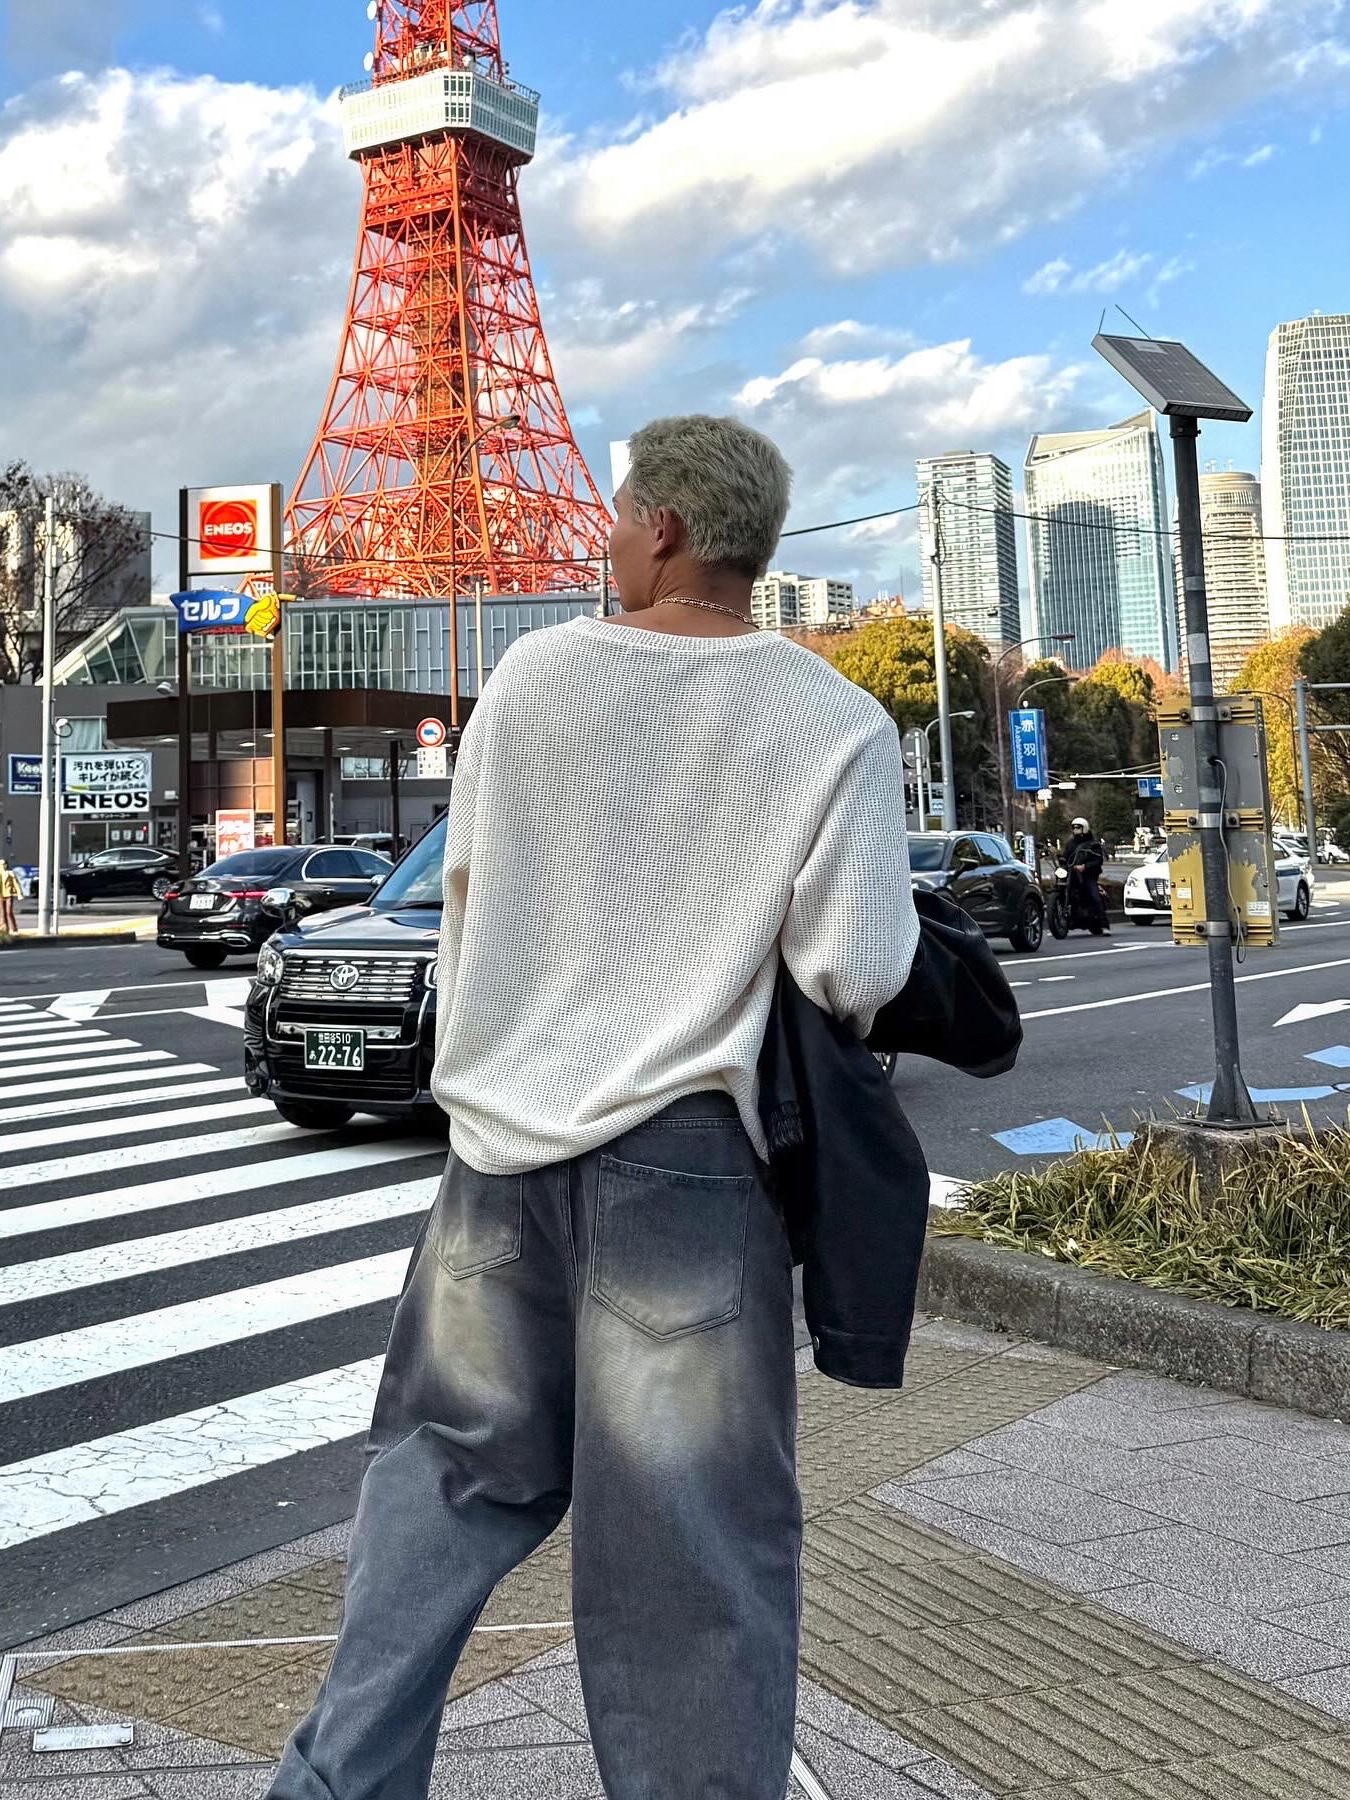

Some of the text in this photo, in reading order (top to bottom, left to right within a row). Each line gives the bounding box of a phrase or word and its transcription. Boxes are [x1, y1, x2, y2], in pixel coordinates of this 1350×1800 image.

[204, 522, 253, 536] ENEOS
[181, 598, 240, 621] セルフ
[63, 791, 148, 809] ENEOS
[318, 1045, 361, 1066] 22-76
